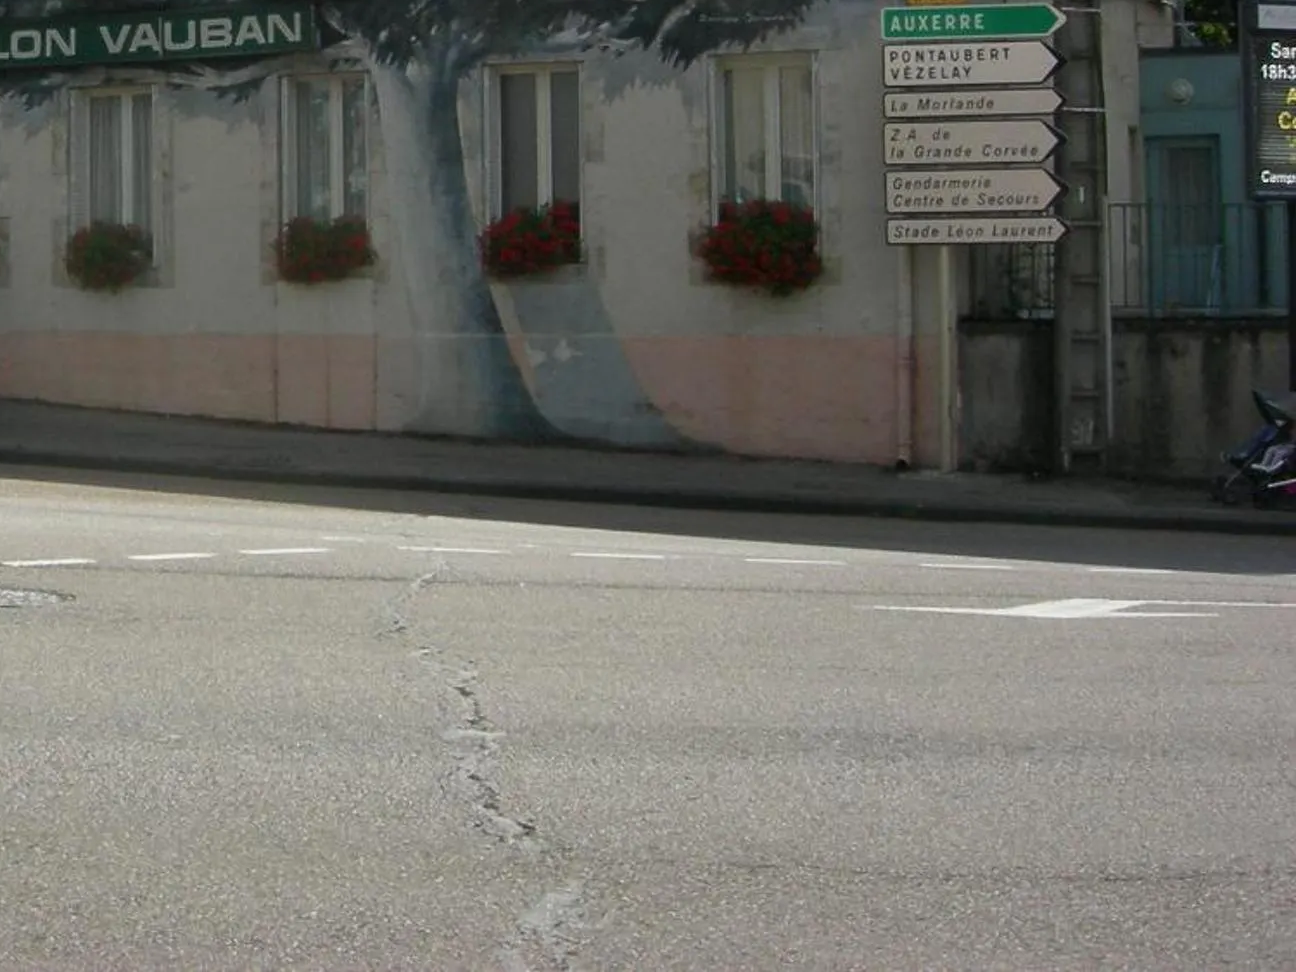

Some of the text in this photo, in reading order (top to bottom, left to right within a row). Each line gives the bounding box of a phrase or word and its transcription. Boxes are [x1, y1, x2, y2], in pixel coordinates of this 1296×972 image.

[890, 13, 985, 31] AUXERRE
[100, 11, 302, 56] VAUBAN
[889, 48, 1011, 63] PONTAUBERT
[890, 64, 972, 80] VÉZELAY
[891, 101, 908, 112] La
[932, 128, 950, 140] de
[890, 147, 904, 159] la
[914, 145, 972, 158] Grande
[893, 178, 991, 190] Gendarmerie
[893, 192, 1039, 208] Centre de Secours
[893, 225, 940, 238] Stade
[992, 224, 1053, 238] Laurent
